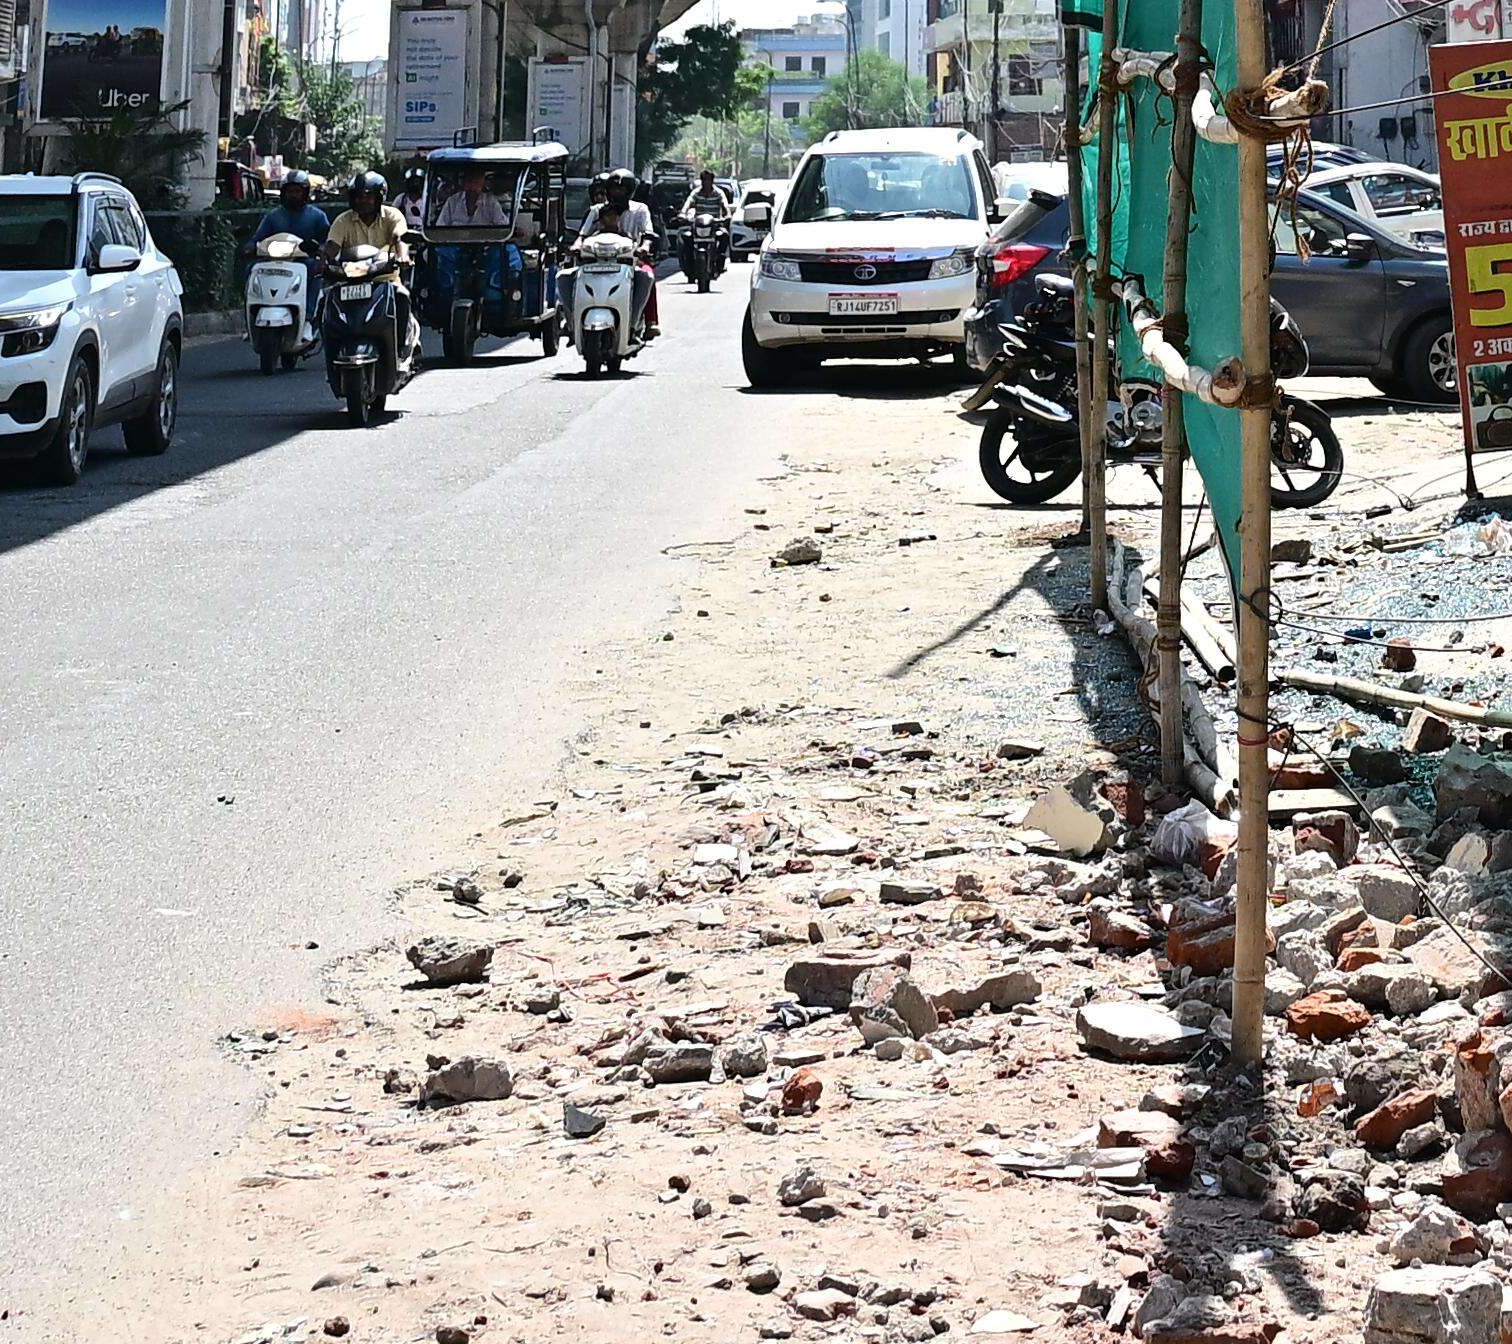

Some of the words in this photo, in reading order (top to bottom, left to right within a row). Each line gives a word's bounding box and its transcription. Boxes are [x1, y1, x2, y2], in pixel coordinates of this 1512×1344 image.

[98, 88, 150, 108] Uber
[1458, 217, 1496, 238] राज्य
[836, 301, 896, 313] RJ14UF7251
[1473, 340, 1484, 358] 2
